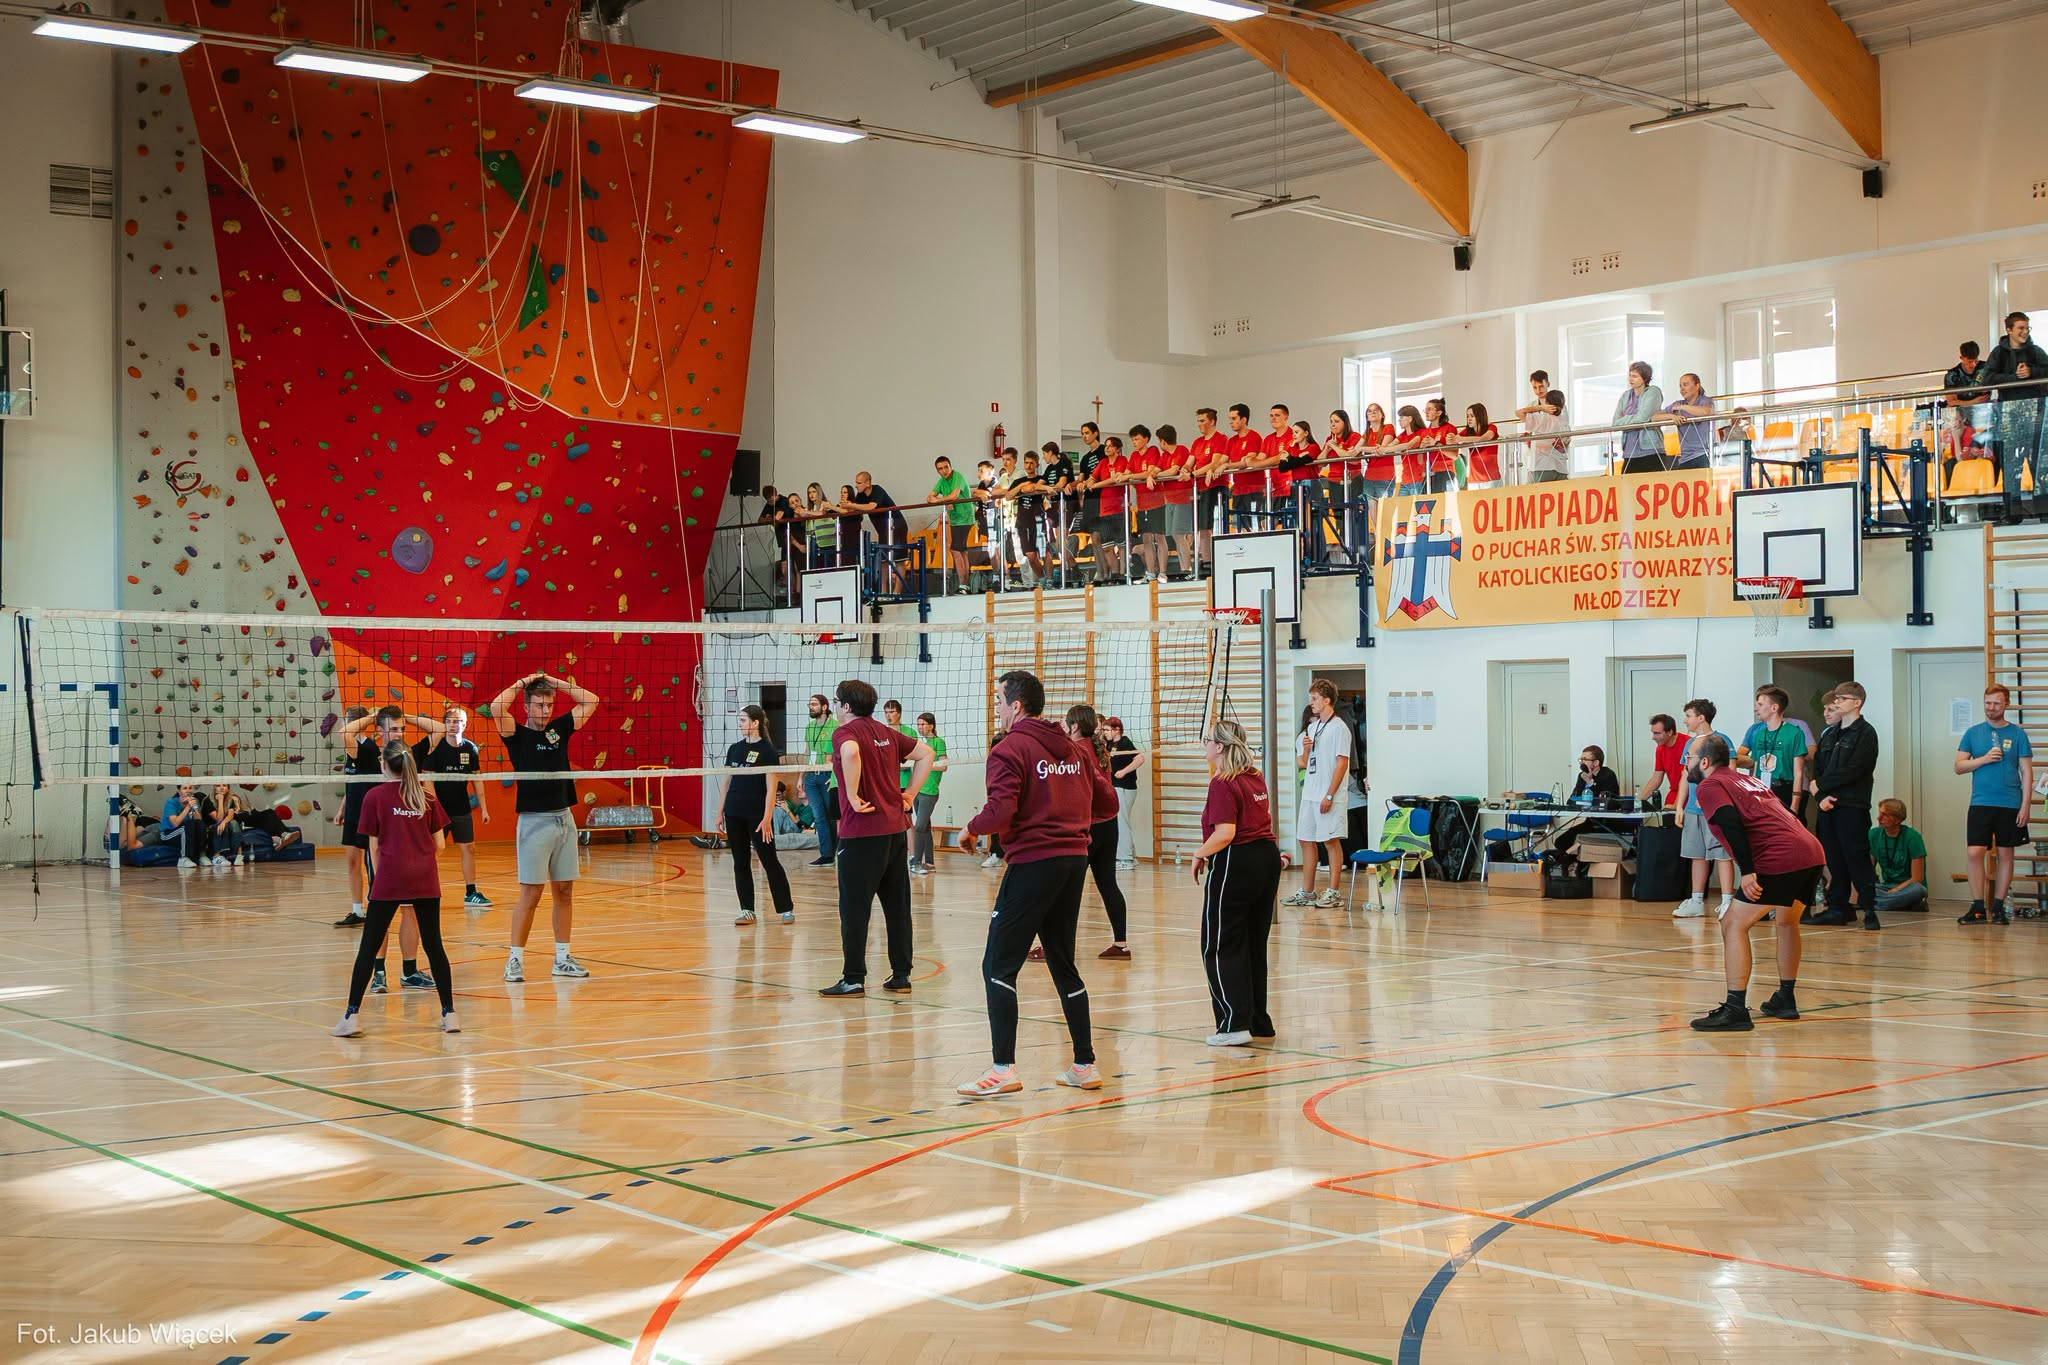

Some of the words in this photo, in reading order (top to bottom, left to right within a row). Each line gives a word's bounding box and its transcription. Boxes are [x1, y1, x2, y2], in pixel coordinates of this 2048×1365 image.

[1473, 487, 1618, 534] OLIMPIADA
[1635, 474, 1789, 521] SPORT
[1472, 544, 1485, 561] O
[1489, 537, 1561, 560] PUCHAR
[1565, 532, 1597, 554] ŚW.
[1601, 527, 1720, 552] STANISŁAWA
[1478, 562, 1608, 588] KATOLICKIEGO
[1573, 585, 1681, 611] MŁODZIEŻY
